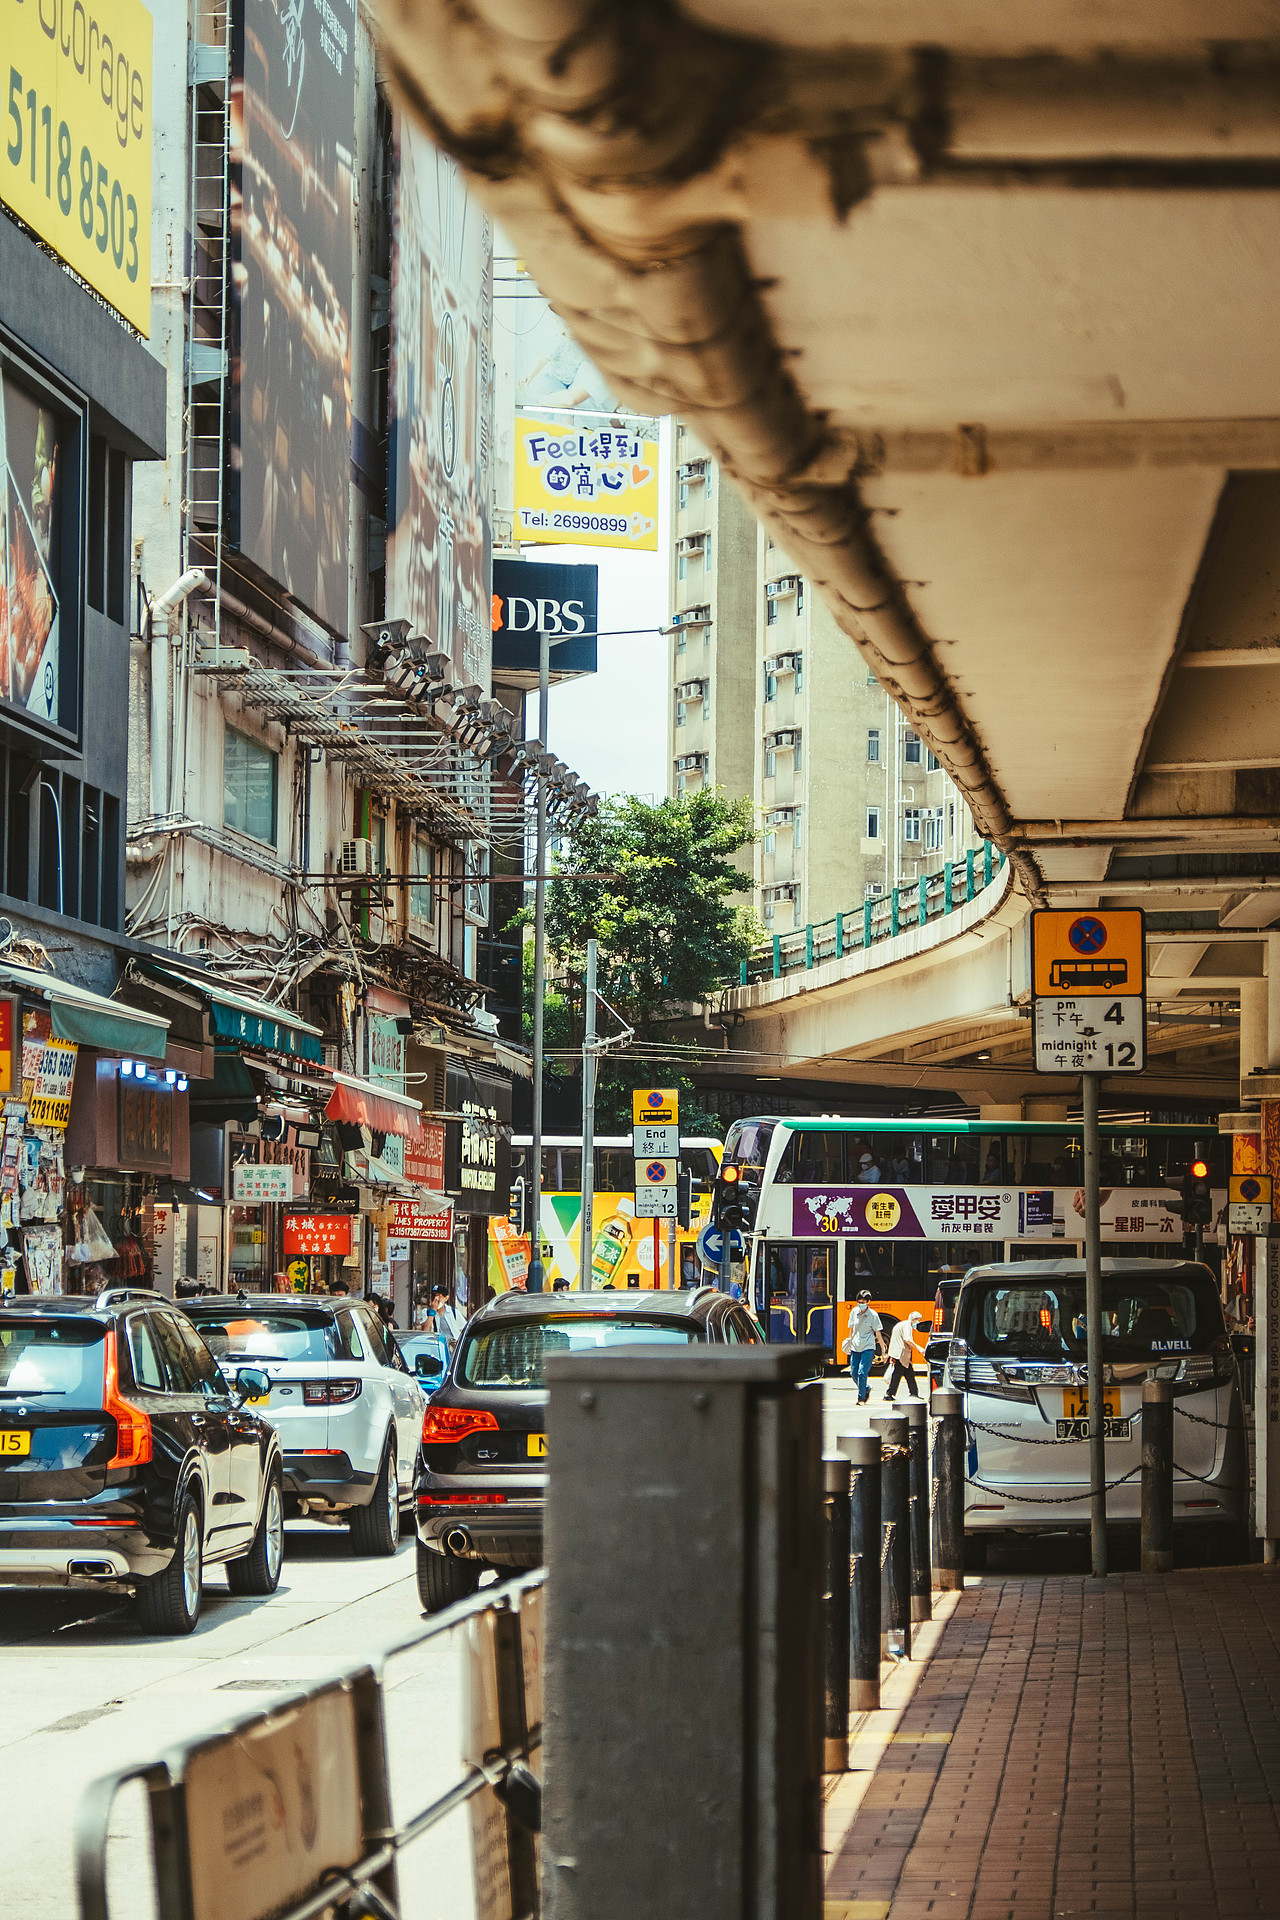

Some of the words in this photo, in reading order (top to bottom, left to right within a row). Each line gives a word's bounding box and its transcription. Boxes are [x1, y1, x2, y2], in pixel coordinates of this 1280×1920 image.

[8, 64, 72, 217] 5118
[79, 145, 139, 284] 8503
[522, 511, 548, 526] Tel:
[553, 514, 627, 533] 26990899
[506, 597, 585, 634] DBS
[1057, 1001, 1076, 1010] pm
[1052, 1013, 1084, 1027] 下午
[1104, 1002, 1124, 1025] 4
[1042, 1040, 1098, 1053] midnight
[1105, 1042, 1136, 1067] 12
[1054, 1055, 1085, 1068] 午夜
[31, 1099, 70, 1122] 27811682
[646, 1129, 666, 1138] End
[642, 1142, 670, 1154] 終止
[662, 1189, 668, 1198] 7
[662, 1204, 675, 1214] 12
[1256, 1206, 1262, 1216] 7
[414, 1218, 449, 1228] PROPERTY
[821, 1216, 838, 1232] 30
[1271, 1243, 1279, 1309] COASTLINE
[1070, 1403, 1114, 1417] 148
[477, 1450, 499, 1459] Q7
